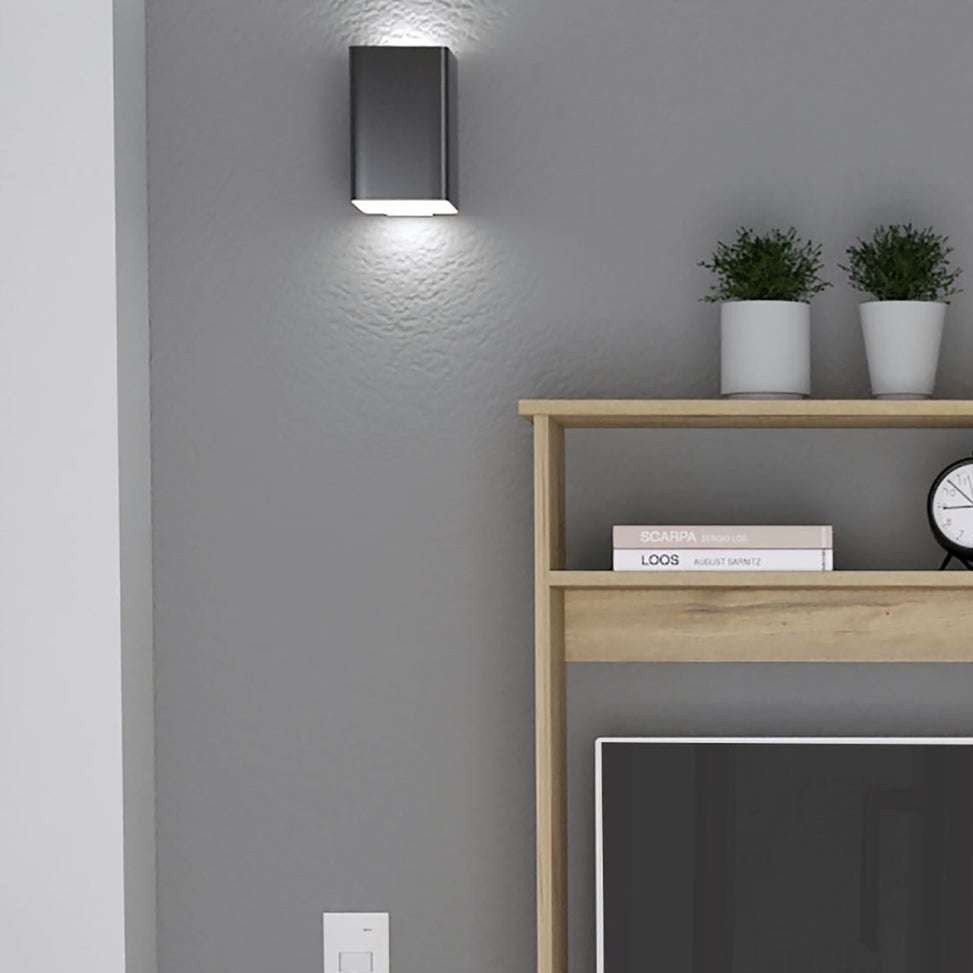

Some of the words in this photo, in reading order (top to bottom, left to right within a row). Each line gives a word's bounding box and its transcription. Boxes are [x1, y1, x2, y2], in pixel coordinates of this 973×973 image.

[640, 530, 697, 543] SCARPA
[641, 554, 680, 566] LOOS
[693, 557, 726, 566] AUGUST
